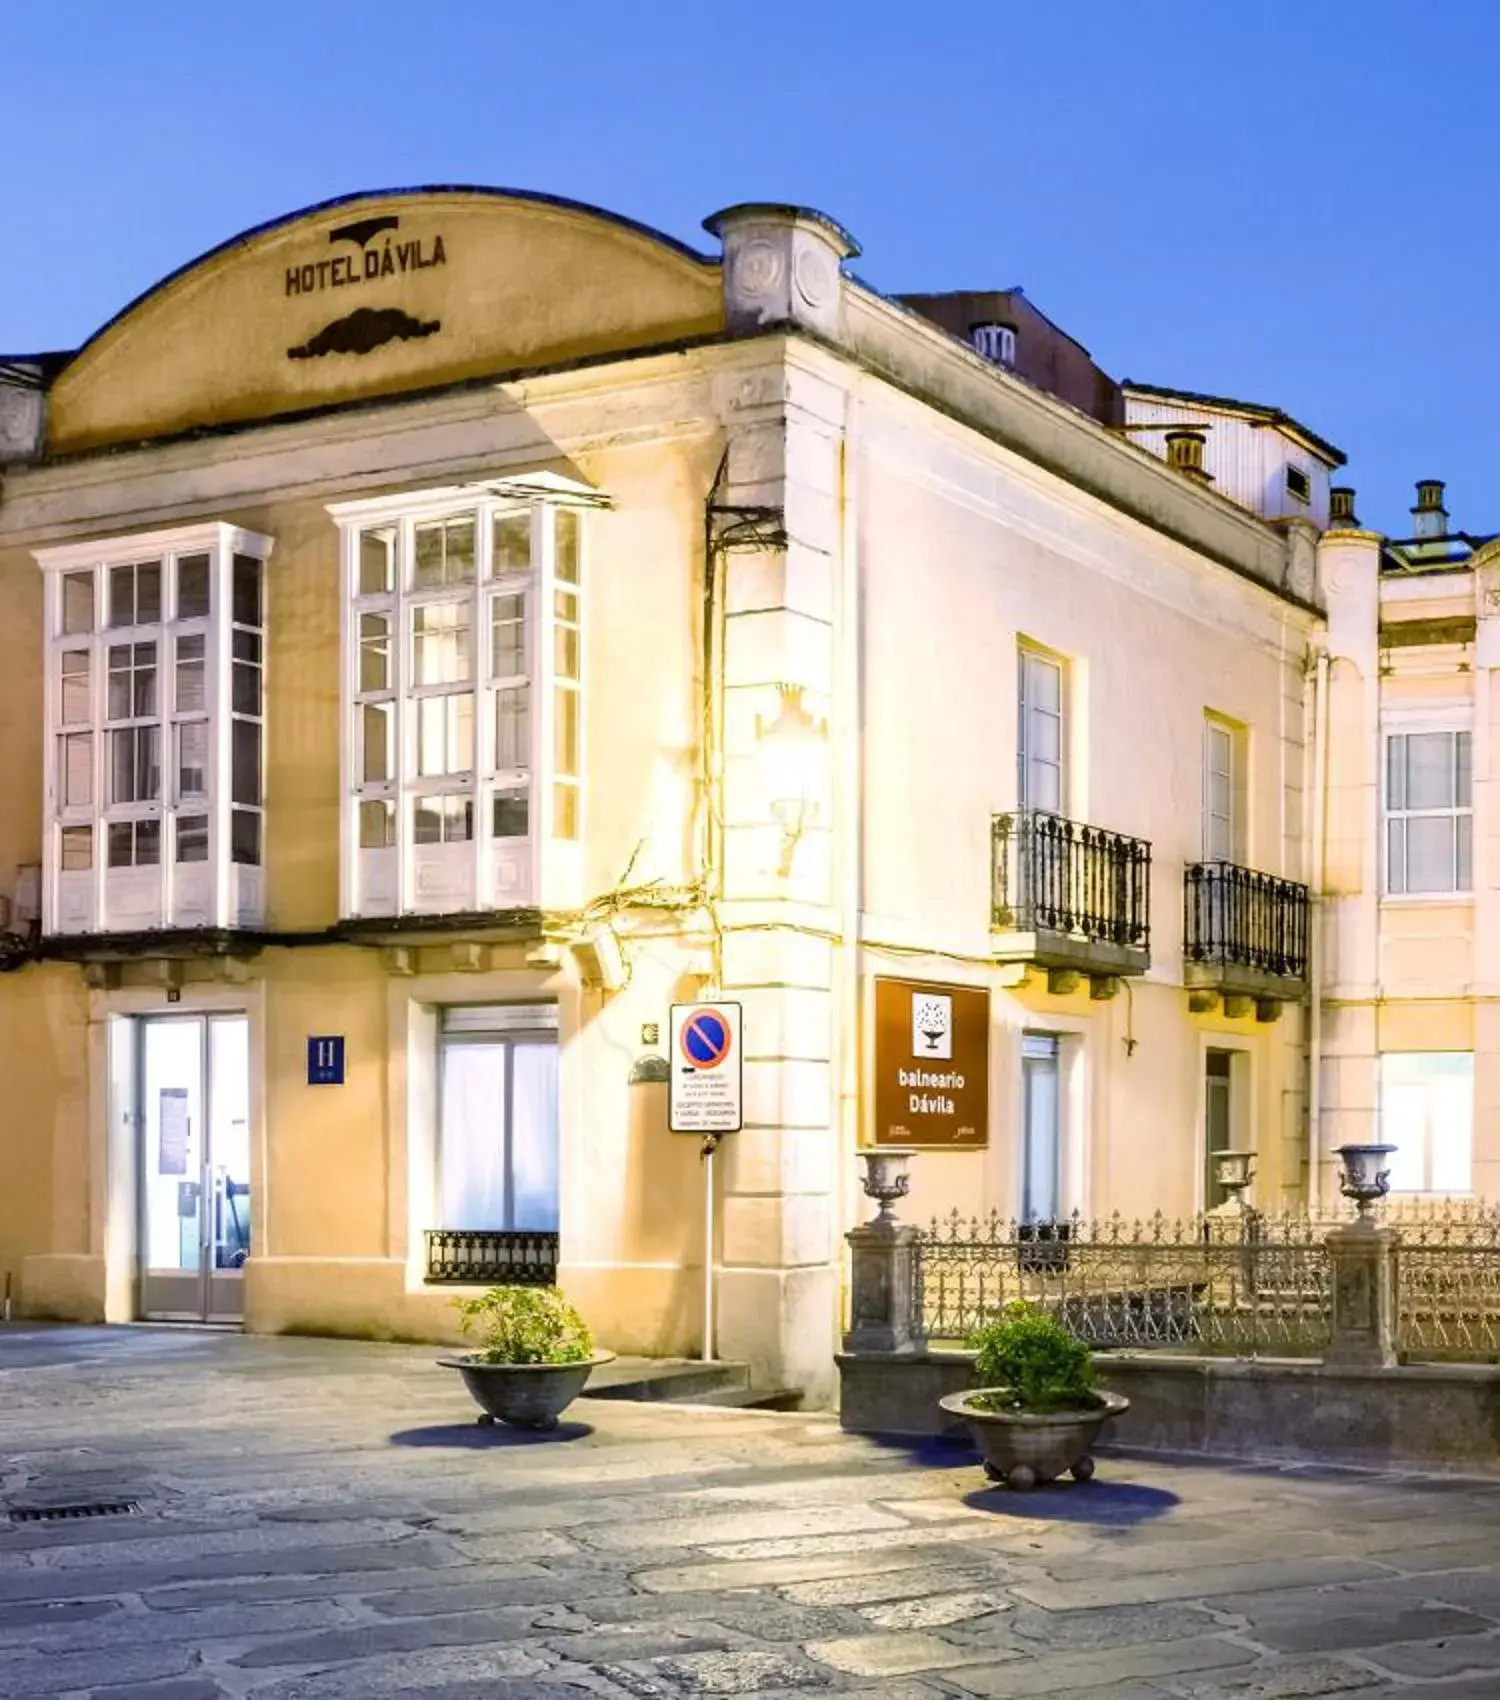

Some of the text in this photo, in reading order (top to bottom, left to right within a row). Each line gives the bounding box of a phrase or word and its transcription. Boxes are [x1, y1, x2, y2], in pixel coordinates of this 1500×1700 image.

[285, 234, 447, 297] HOTEL DÁVILA
[898, 1068, 966, 1089] balneario
[909, 1093, 955, 1115] Dávila
